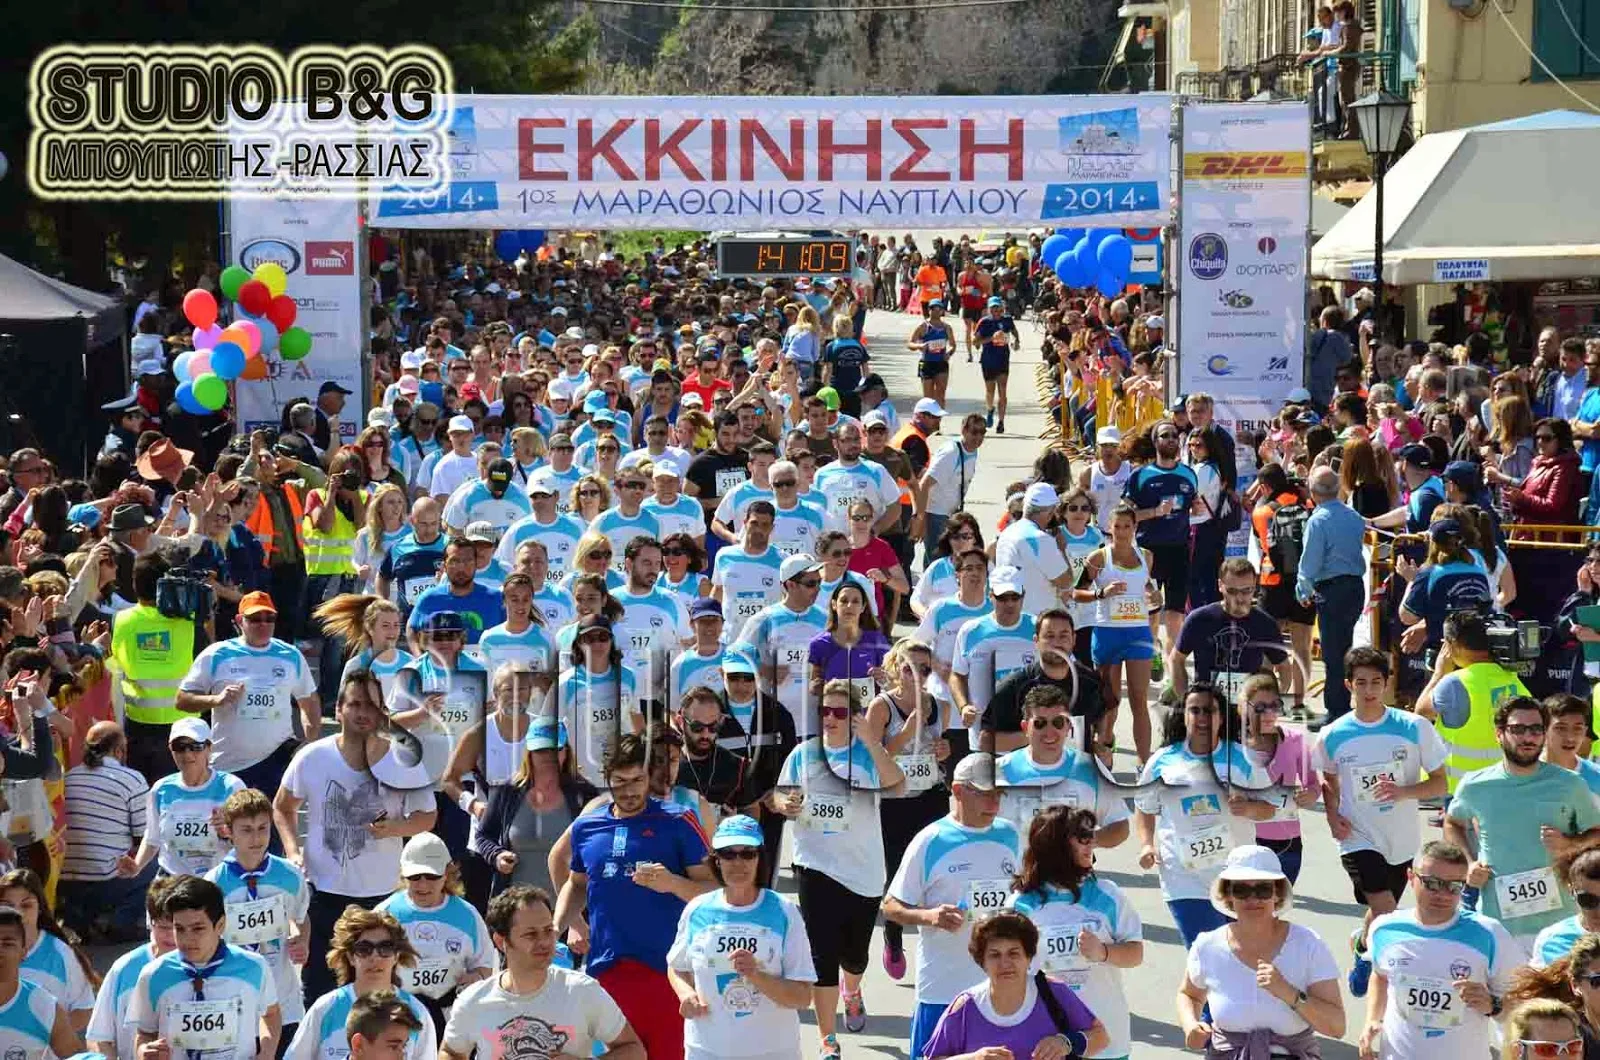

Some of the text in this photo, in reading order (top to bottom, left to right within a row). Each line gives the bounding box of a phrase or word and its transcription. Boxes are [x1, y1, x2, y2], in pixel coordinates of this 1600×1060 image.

[518, 117, 1024, 182] ΕΚΚΙΝΗΣΗ
[1202, 155, 1289, 176] DHL
[571, 187, 825, 215] ΜΑΡΑΘΩΝΙΟΣ
[839, 187, 1029, 216] ΝΑΥΠΛΙΟΥ
[1063, 187, 1137, 210] 2014
[1190, 257, 1227, 272] Chiquita
[837, 496, 856, 506] 581
[1117, 602, 1142, 614] 2585
[246, 692, 276, 707] 5803
[440, 710, 469, 723] 5795
[1361, 771, 1397, 790] 544
[811, 803, 845, 819] 5898
[174, 822, 210, 837] 5824
[1190, 835, 1225, 858] 5232
[973, 891, 1007, 908] 5632
[1508, 880, 1548, 902] 5450
[237, 908, 275, 930] 5641
[716, 936, 758, 955] 5808
[1047, 935, 1077, 955] 507
[411, 968, 449, 987] 5867
[1407, 988, 1452, 1011] 5092
[181, 1013, 226, 1032] 5664
